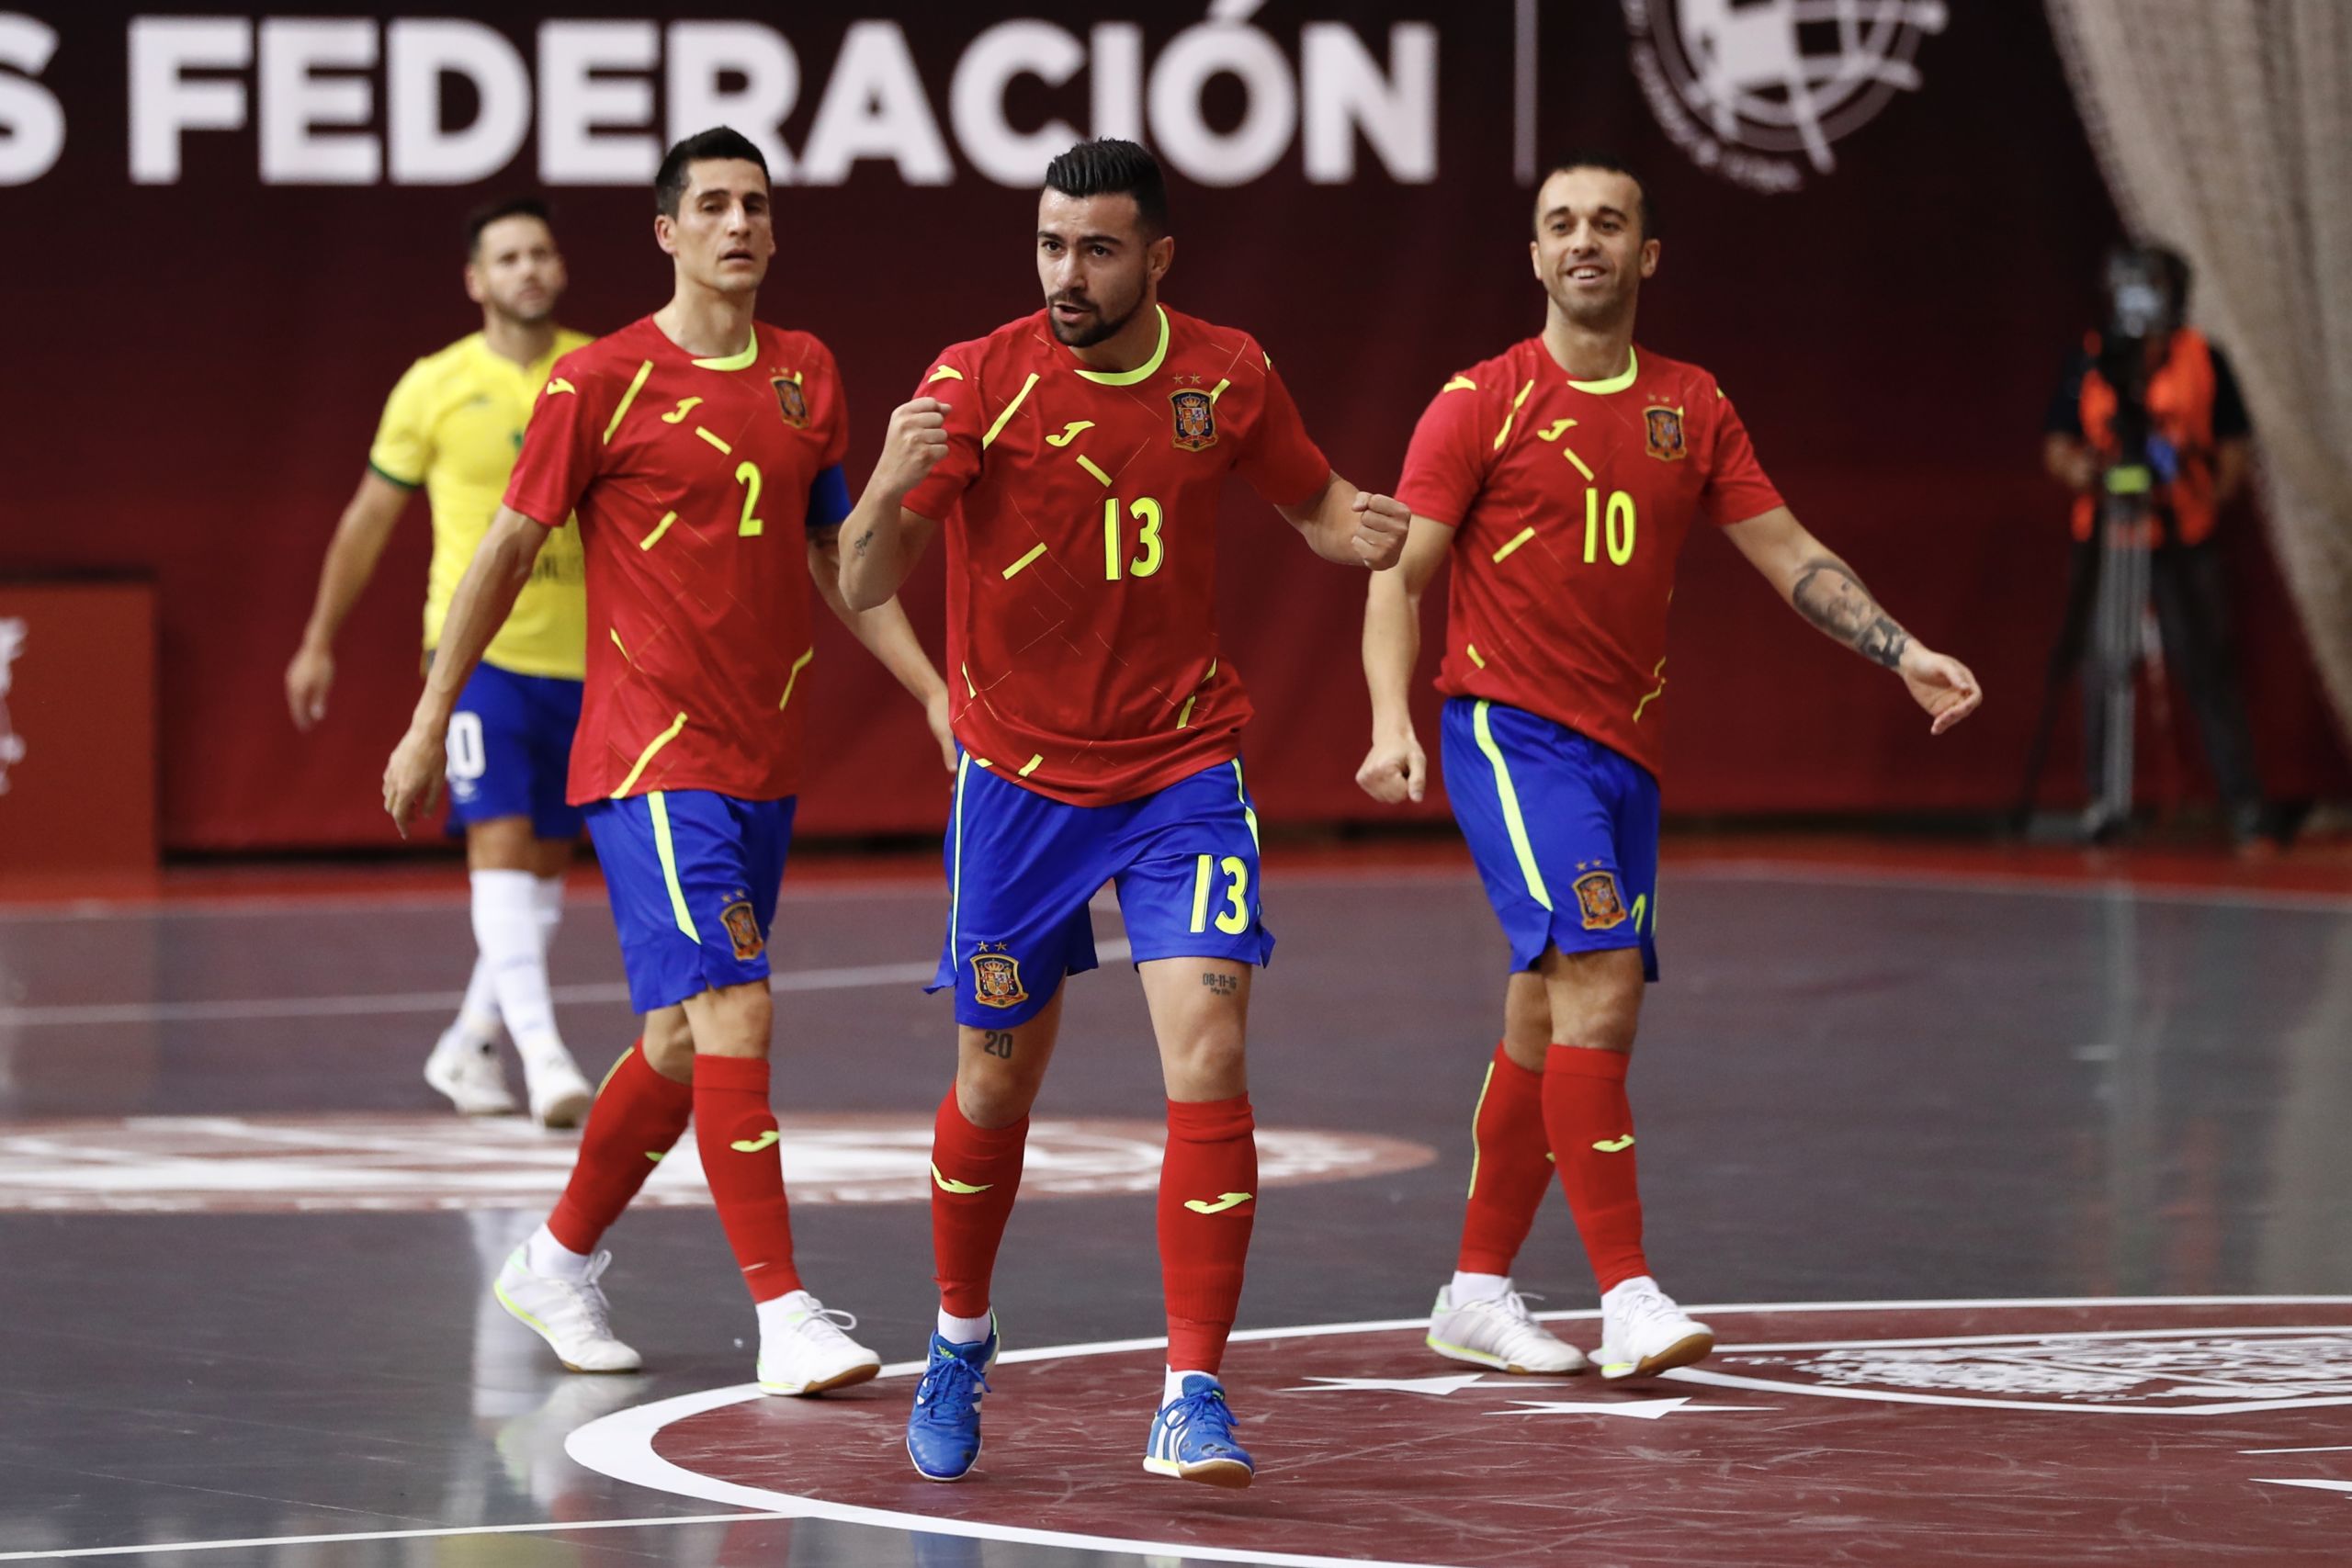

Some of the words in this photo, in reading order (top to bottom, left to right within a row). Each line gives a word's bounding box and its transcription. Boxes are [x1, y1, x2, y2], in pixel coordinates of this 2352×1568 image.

[129, 0, 1438, 188] FEDERACIÓN
[735, 461, 763, 536] 2
[1584, 488, 1636, 566] 10
[1104, 497, 1164, 581] 13
[1191, 854, 1250, 934] 13
[984, 1031, 1013, 1059] 20
